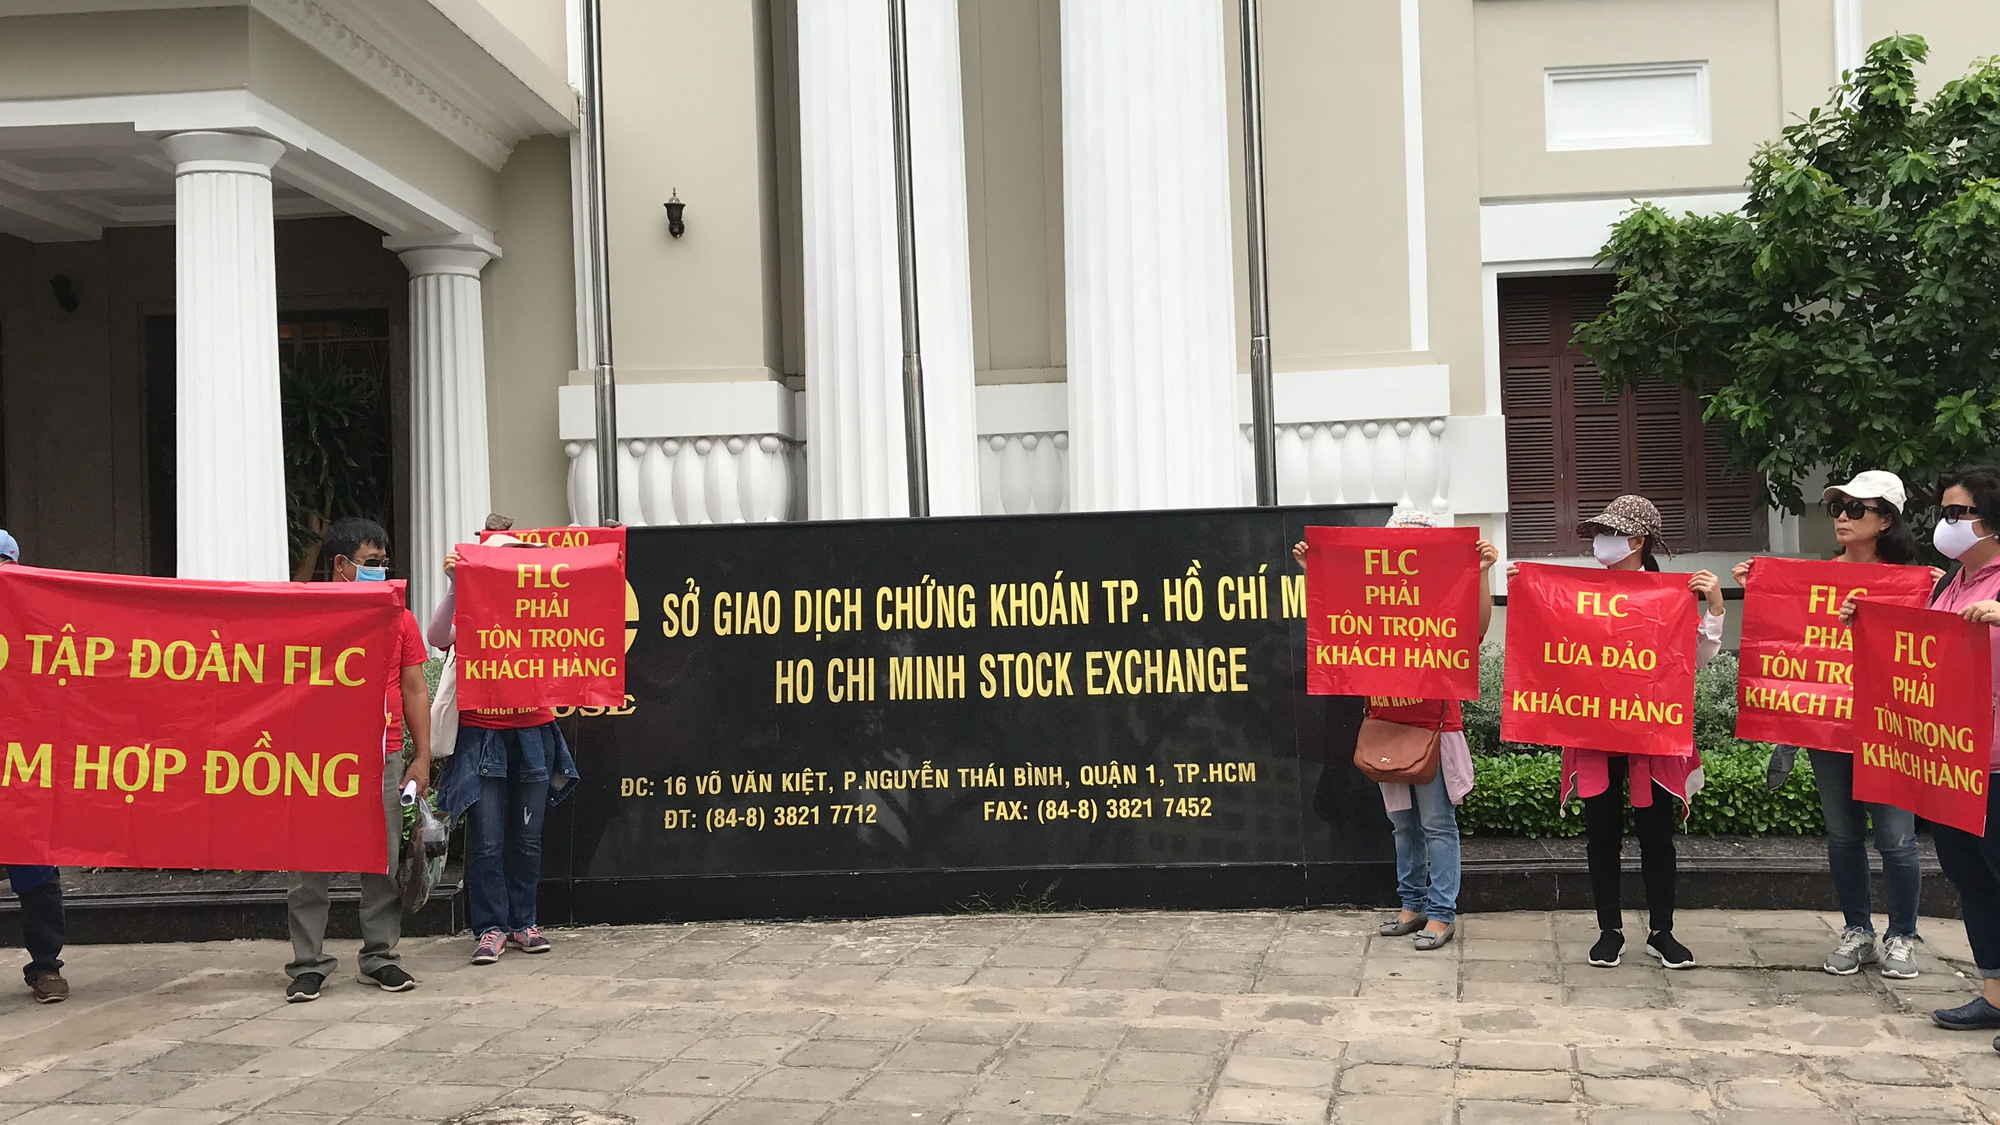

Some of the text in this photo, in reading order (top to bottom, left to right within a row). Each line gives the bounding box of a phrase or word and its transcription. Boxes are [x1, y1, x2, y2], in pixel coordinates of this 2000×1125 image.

[547, 527, 589, 549] CÁO
[517, 563, 570, 589] FLC
[1364, 549, 1419, 576] FLC
[515, 592, 569, 618] PHẢI
[662, 577, 701, 638] SỞ
[713, 589, 781, 637] GIAO
[794, 587, 862, 642] DỊCH
[876, 574, 976, 631] CHỨNG
[990, 570, 1090, 627] KHOÁN
[1101, 579, 1149, 624] TP.
[1163, 559, 1204, 622] HỒ
[1217, 563, 1268, 622] CHÍ
[1365, 579, 1420, 606] PHẢI
[1576, 590, 1629, 618] FLC
[476, 623, 605, 653] TÔN TRỌNG
[1327, 609, 1457, 642] TÔN TRỌNG
[25, 623, 115, 687] TẬP
[128, 629, 265, 684] ĐOÀN
[283, 645, 366, 687] FLC
[465, 652, 617, 680] KHÁCH HÀNG
[1316, 640, 1470, 670] KHÁCH HÀNG
[1544, 636, 1657, 671] LỪA ĐẢO
[1759, 650, 1807, 681] TÔN
[1894, 630, 1937, 669] FLC
[775, 646, 1249, 704] HO CHI MINH STOCK EXCHANGE
[1892, 673, 1935, 708] PHẢI
[1512, 687, 1684, 725] KHÁCH HÀNG
[1745, 684, 1827, 717] KHÁCH
[1874, 703, 1975, 754] TÔN TRỌNG
[73, 743, 187, 804] HỢP
[202, 730, 360, 798] ĐỒNG
[620, 760, 1257, 797] ĐC: 16 VÕ VĂN KIỆT, P.NGUYỄN THÁI BÌNH, QUẬN 1, TP.HCM
[1862, 740, 1983, 796] KHÁCH HÀNG
[663, 803, 878, 833] ĐT: (84-8) 3821 7712
[983, 796, 1213, 825] FAX: (84-8) 3821 7452
